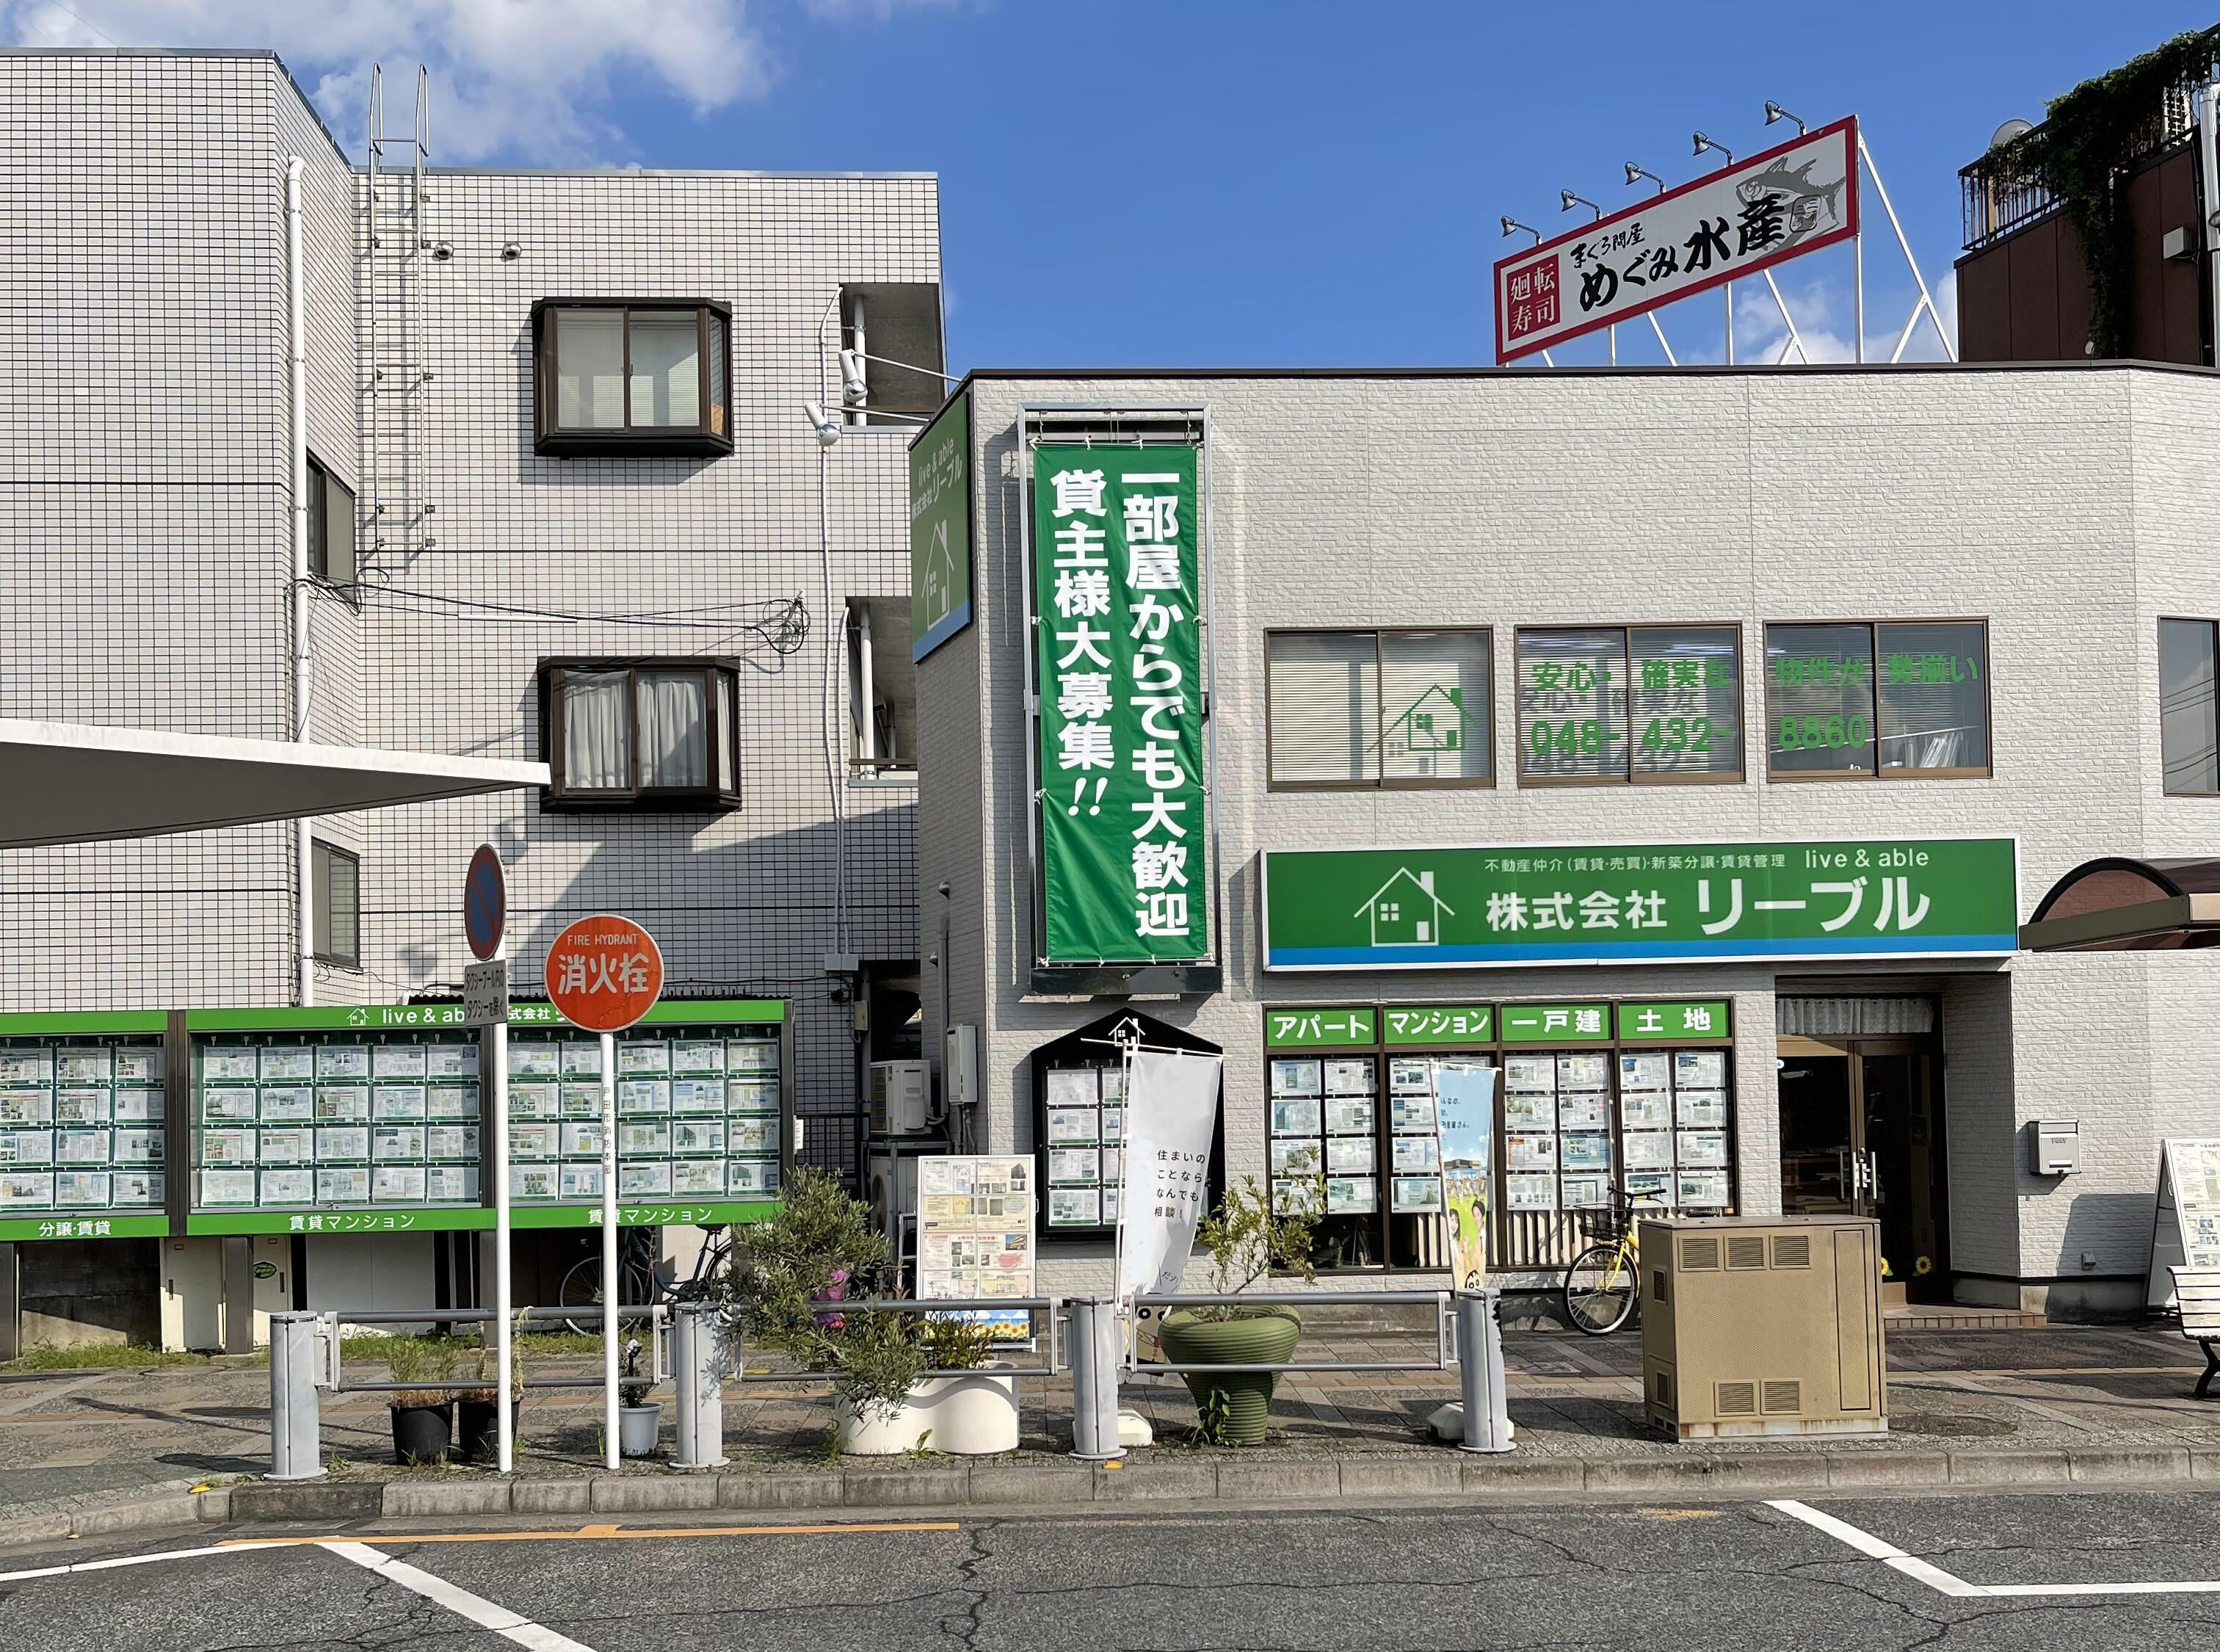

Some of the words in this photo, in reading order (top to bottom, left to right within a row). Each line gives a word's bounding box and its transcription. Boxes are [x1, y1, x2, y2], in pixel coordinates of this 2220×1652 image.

[1579, 193, 1785, 312] めぐみ水産
[1512, 294, 1555, 333] 寿司
[918, 463, 931, 488] live
[938, 437, 954, 466] able
[933, 453, 962, 503] リーブル
[1121, 472, 1190, 937] 一部屋からでも大歓迎
[1779, 714, 1867, 750] 8860
[1805, 849, 1848, 869] live
[1854, 849, 1871, 867] &
[1878, 847, 1929, 867] able
[1485, 889, 1668, 932] 株式会社
[1697, 875, 1931, 935] リーブル
[567, 935, 590, 946] FIRE
[595, 933, 639, 946] HYDRANT
[557, 952, 650, 994] 消火栓
[382, 1008, 417, 1024] live
[423, 1007, 436, 1023] &
[442, 1007, 465, 1023] ab
[508, 1007, 551, 1021] 式会社
[1274, 1013, 1370, 1039] アパート
[1388, 1010, 1489, 1035] マンション
[1512, 1009, 1601, 1033] 一戸建
[603, 1087, 612, 1175] 戸田市消防本部
[1157, 1149, 1205, 1164] 住まいの
[1158, 1169, 1202, 1183] ことなら
[1156, 1187, 1199, 1202] なんでも
[38, 1220, 112, 1237] 分譲・賃貸
[289, 1214, 415, 1231] 賃貸マンション
